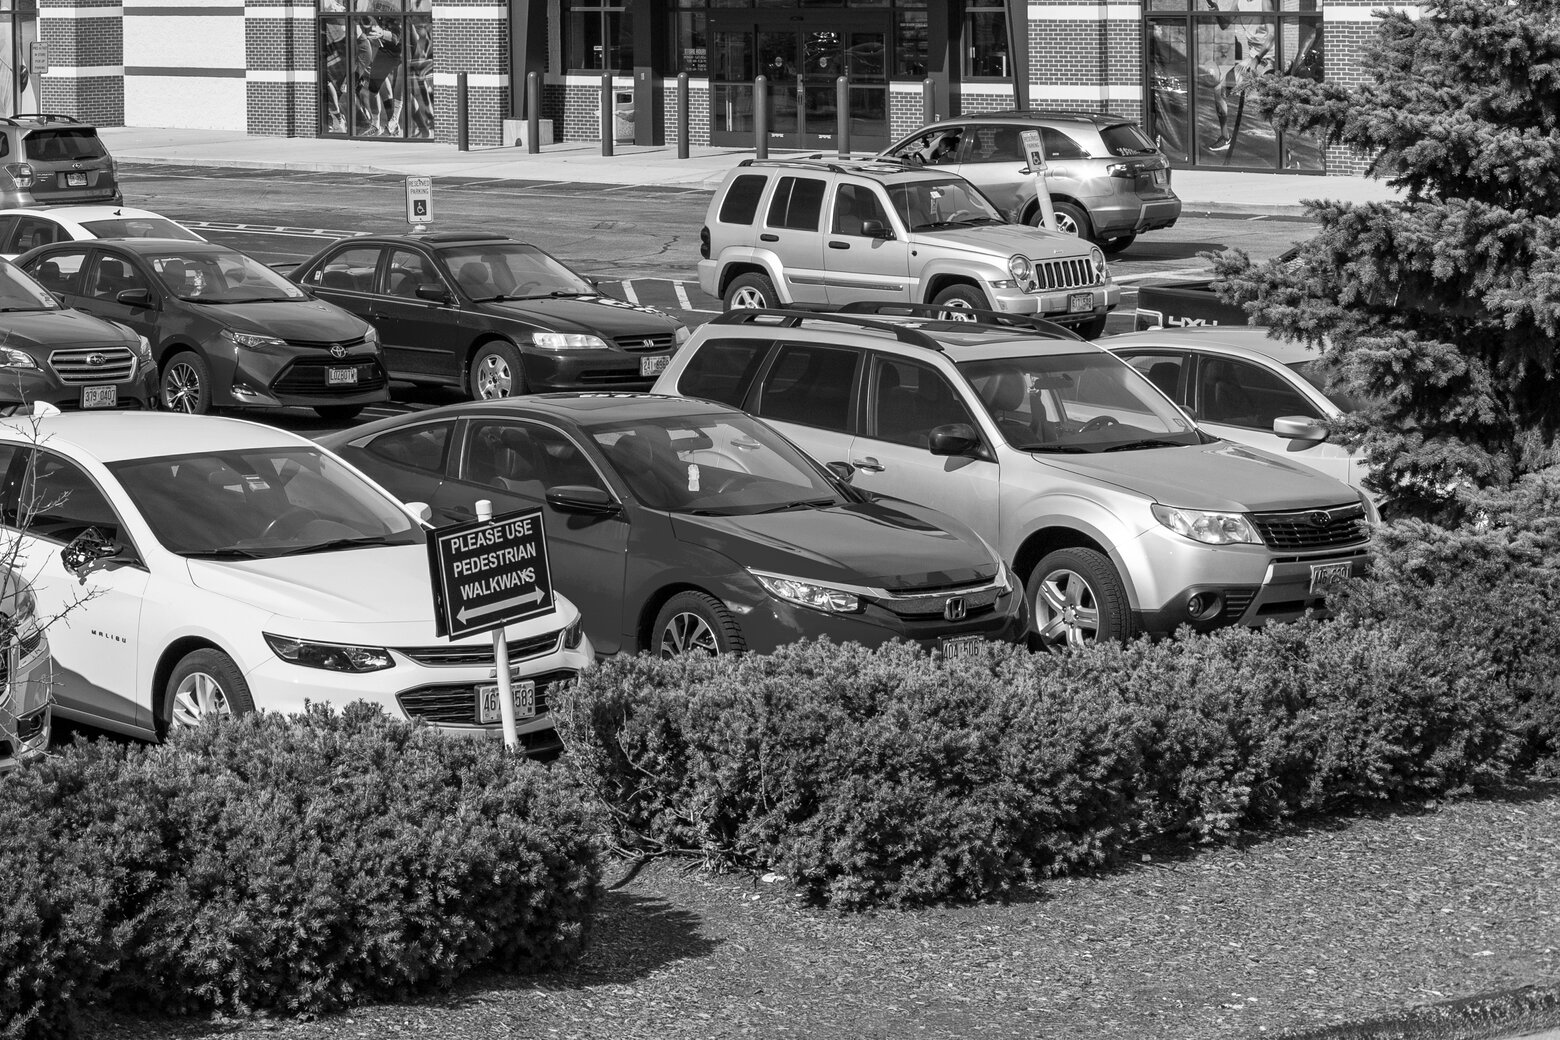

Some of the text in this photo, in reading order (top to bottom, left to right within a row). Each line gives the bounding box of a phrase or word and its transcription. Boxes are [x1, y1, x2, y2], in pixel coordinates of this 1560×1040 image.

[451, 519, 533, 554] PLEASE USE
[453, 541, 536, 578] PEDESTRIAN
[460, 566, 536, 601] WALKWAYS
[91, 629, 127, 644] MALIBU
[511, 688, 534, 708] 583
